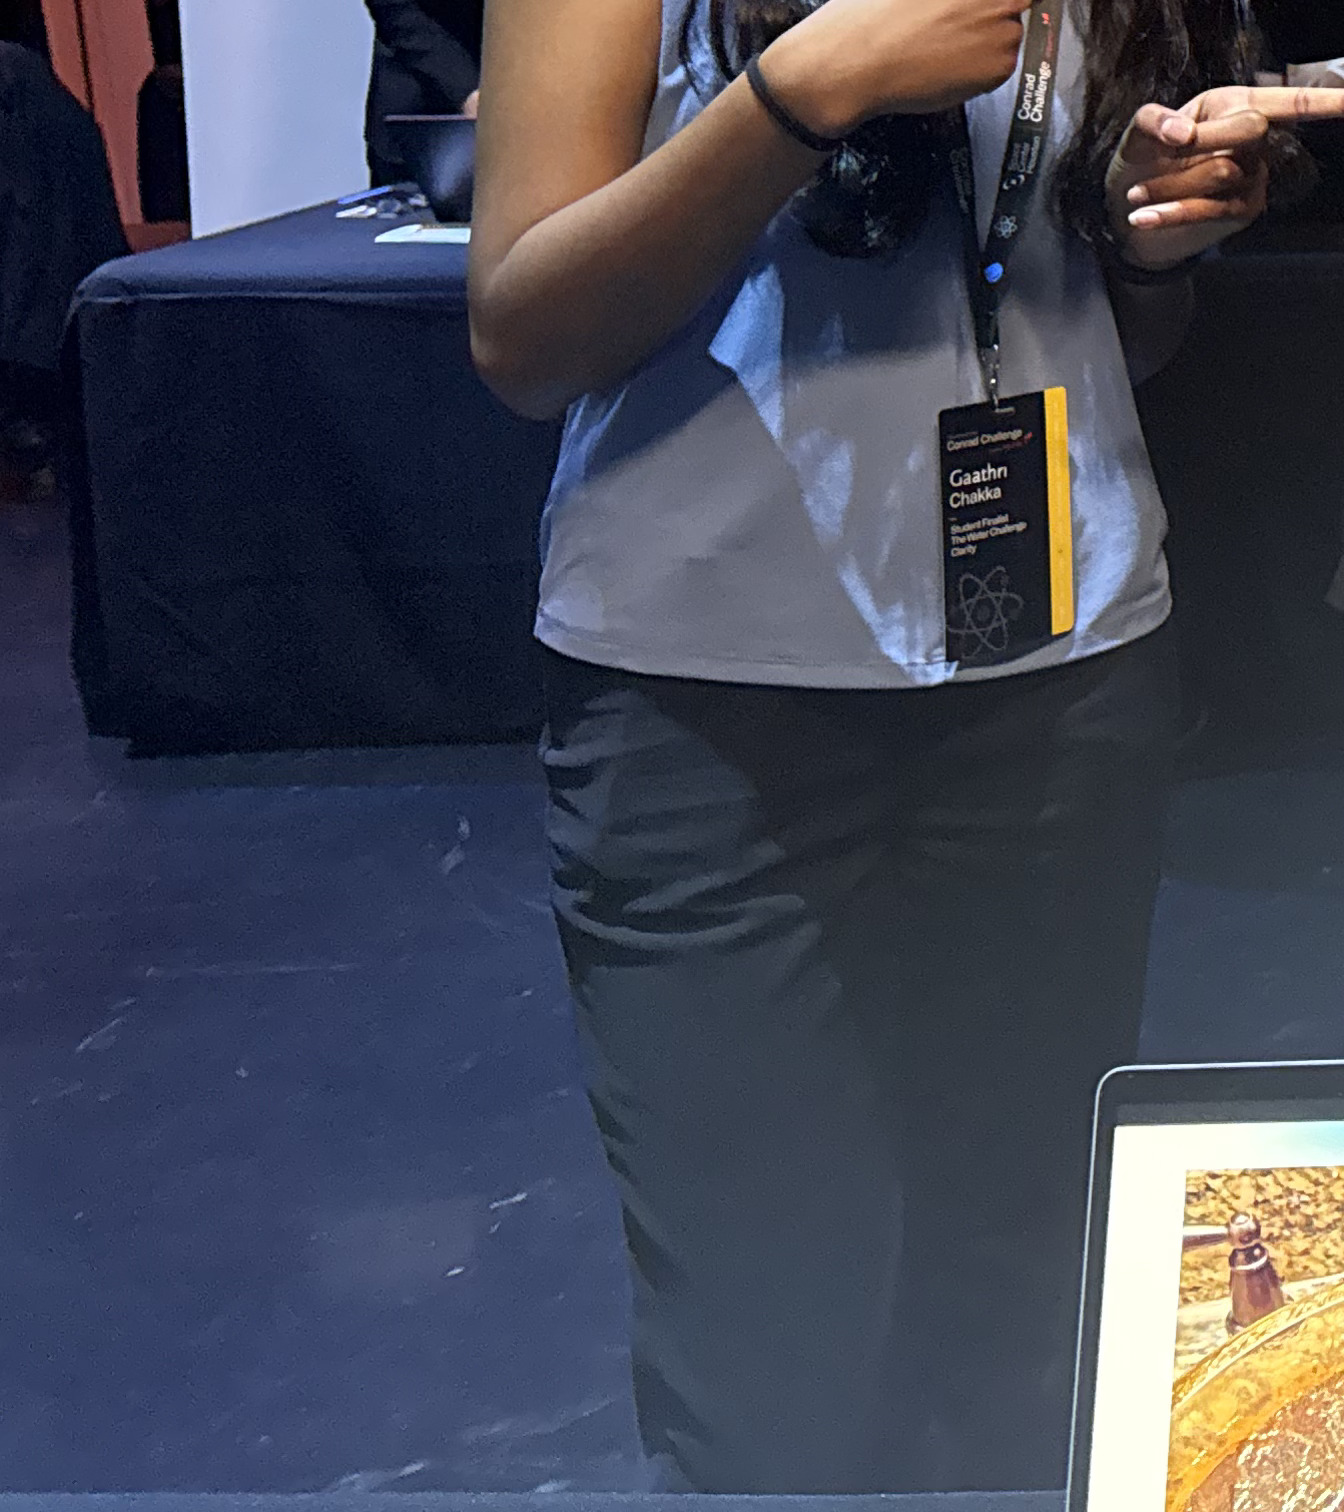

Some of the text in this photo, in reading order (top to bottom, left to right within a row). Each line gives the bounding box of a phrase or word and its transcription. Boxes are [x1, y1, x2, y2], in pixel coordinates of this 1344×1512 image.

[1018, 73, 1036, 120] Conrad
[1030, 61, 1052, 122] Challenge
[949, 486, 1002, 509] Chakka
